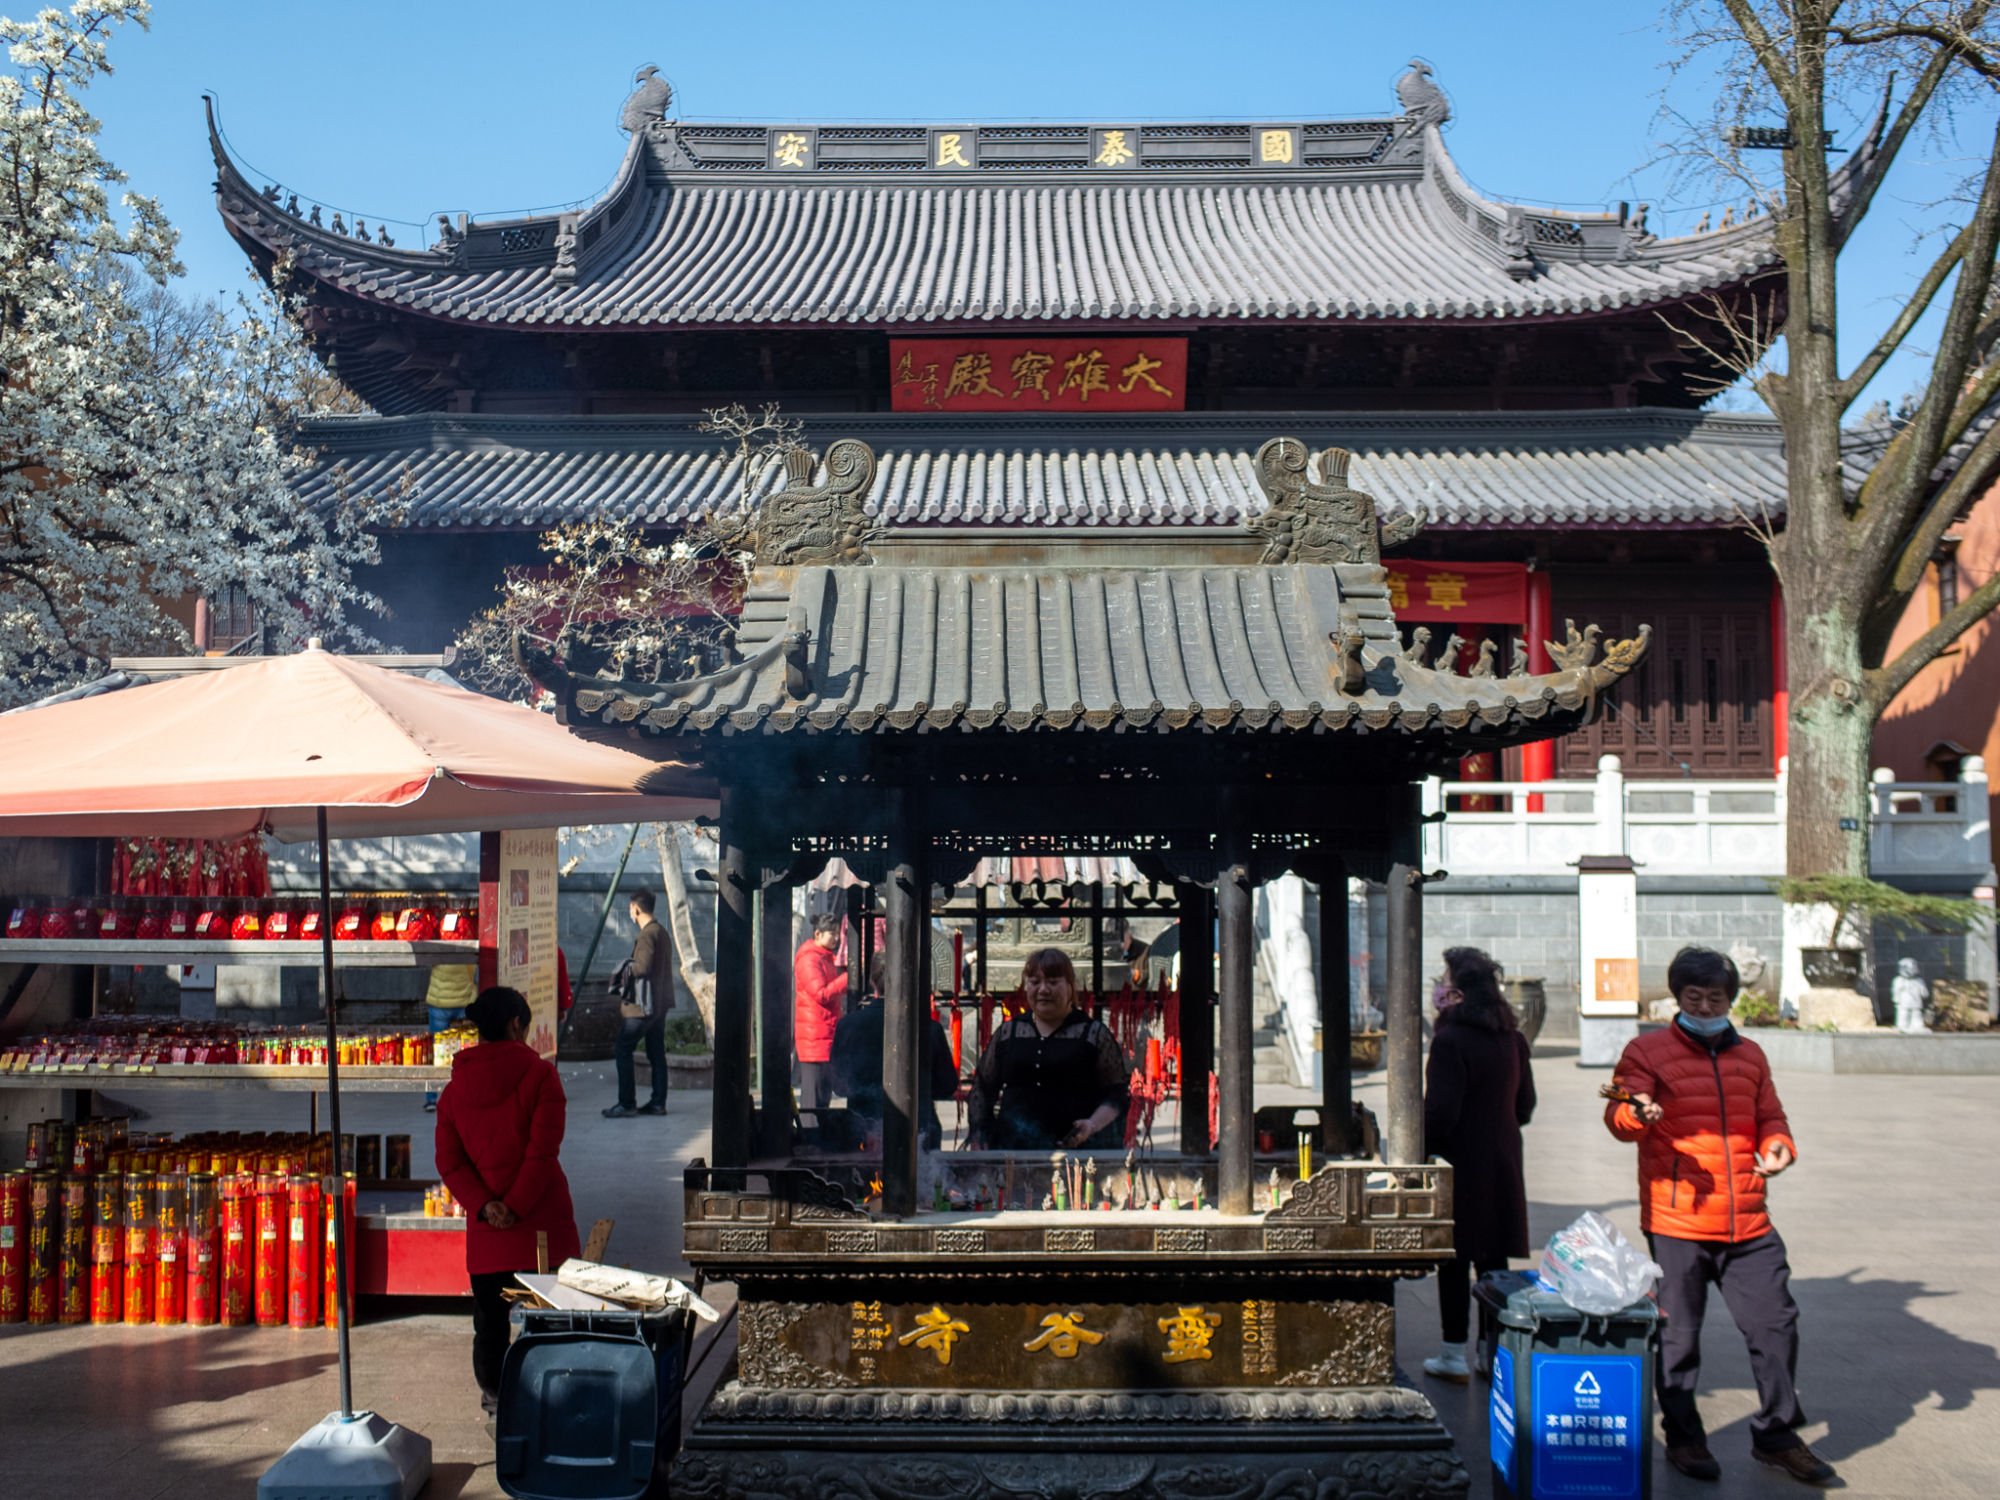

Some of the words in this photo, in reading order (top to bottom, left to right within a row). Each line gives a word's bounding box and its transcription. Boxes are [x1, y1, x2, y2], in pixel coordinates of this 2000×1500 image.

[1546, 1414, 1627, 1429] 本桶只可投放
